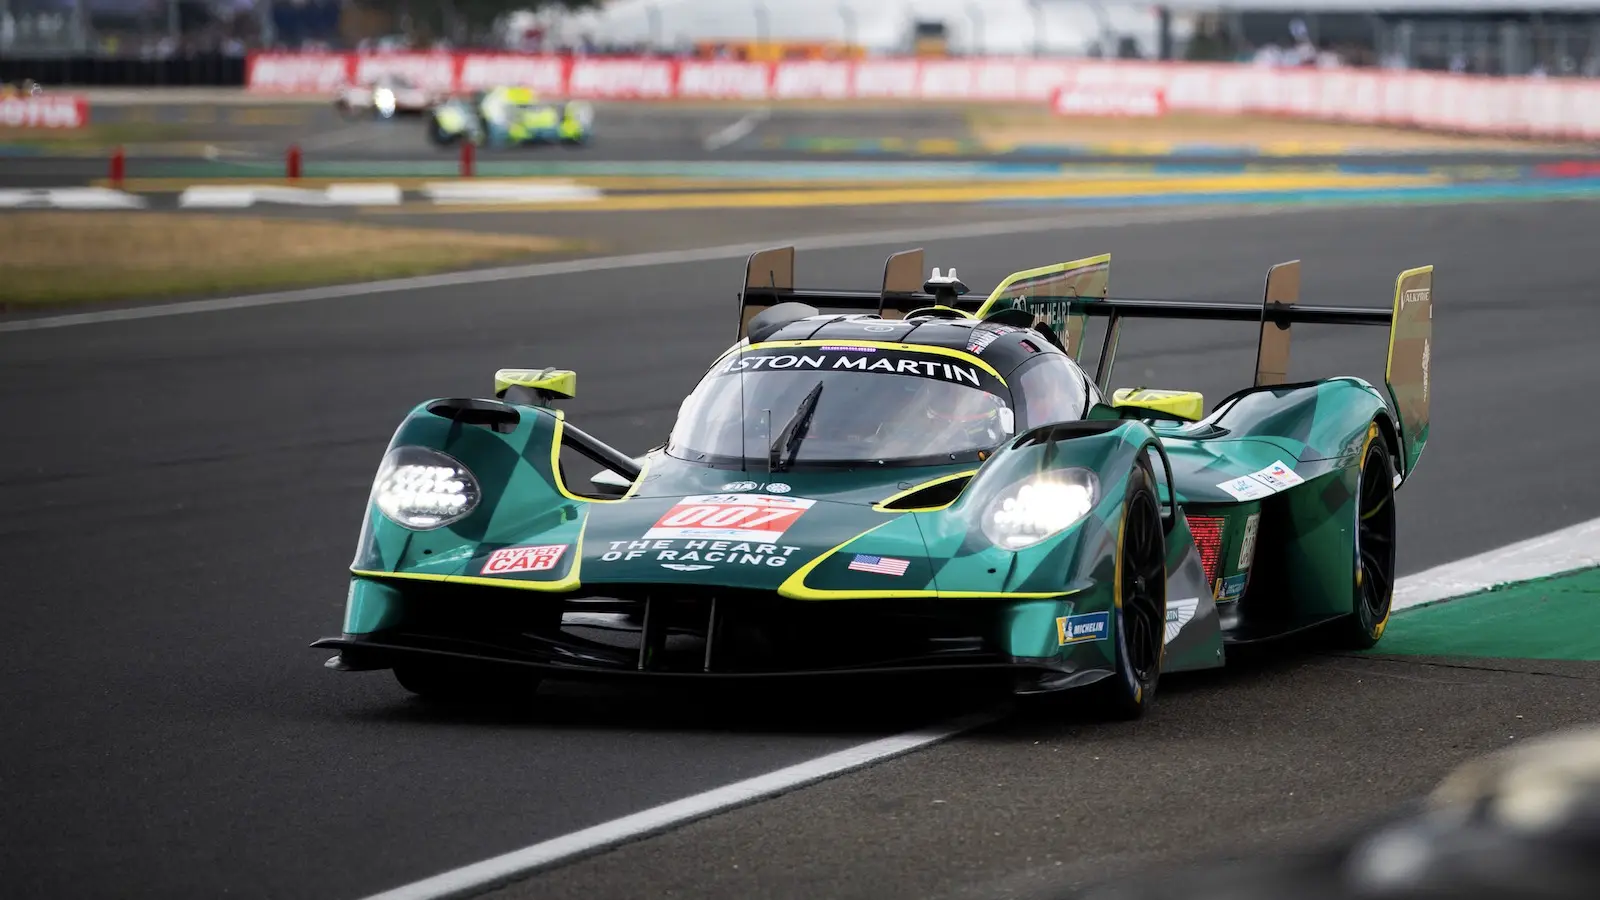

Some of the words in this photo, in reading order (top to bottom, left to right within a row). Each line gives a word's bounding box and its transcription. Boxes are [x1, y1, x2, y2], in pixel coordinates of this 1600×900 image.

[1046, 301, 1072, 325] HEART
[718, 354, 826, 373] ASTON
[832, 356, 981, 387] MARTIN
[660, 505, 800, 529] 007
[495, 547, 560, 559] HYPER
[609, 540, 669, 550] THE
[685, 541, 801, 556] HEART
[489, 555, 554, 571] CAR
[601, 550, 646, 561] OF
[656, 550, 788, 567] RACING
[1073, 621, 1105, 635] MICHELIN
